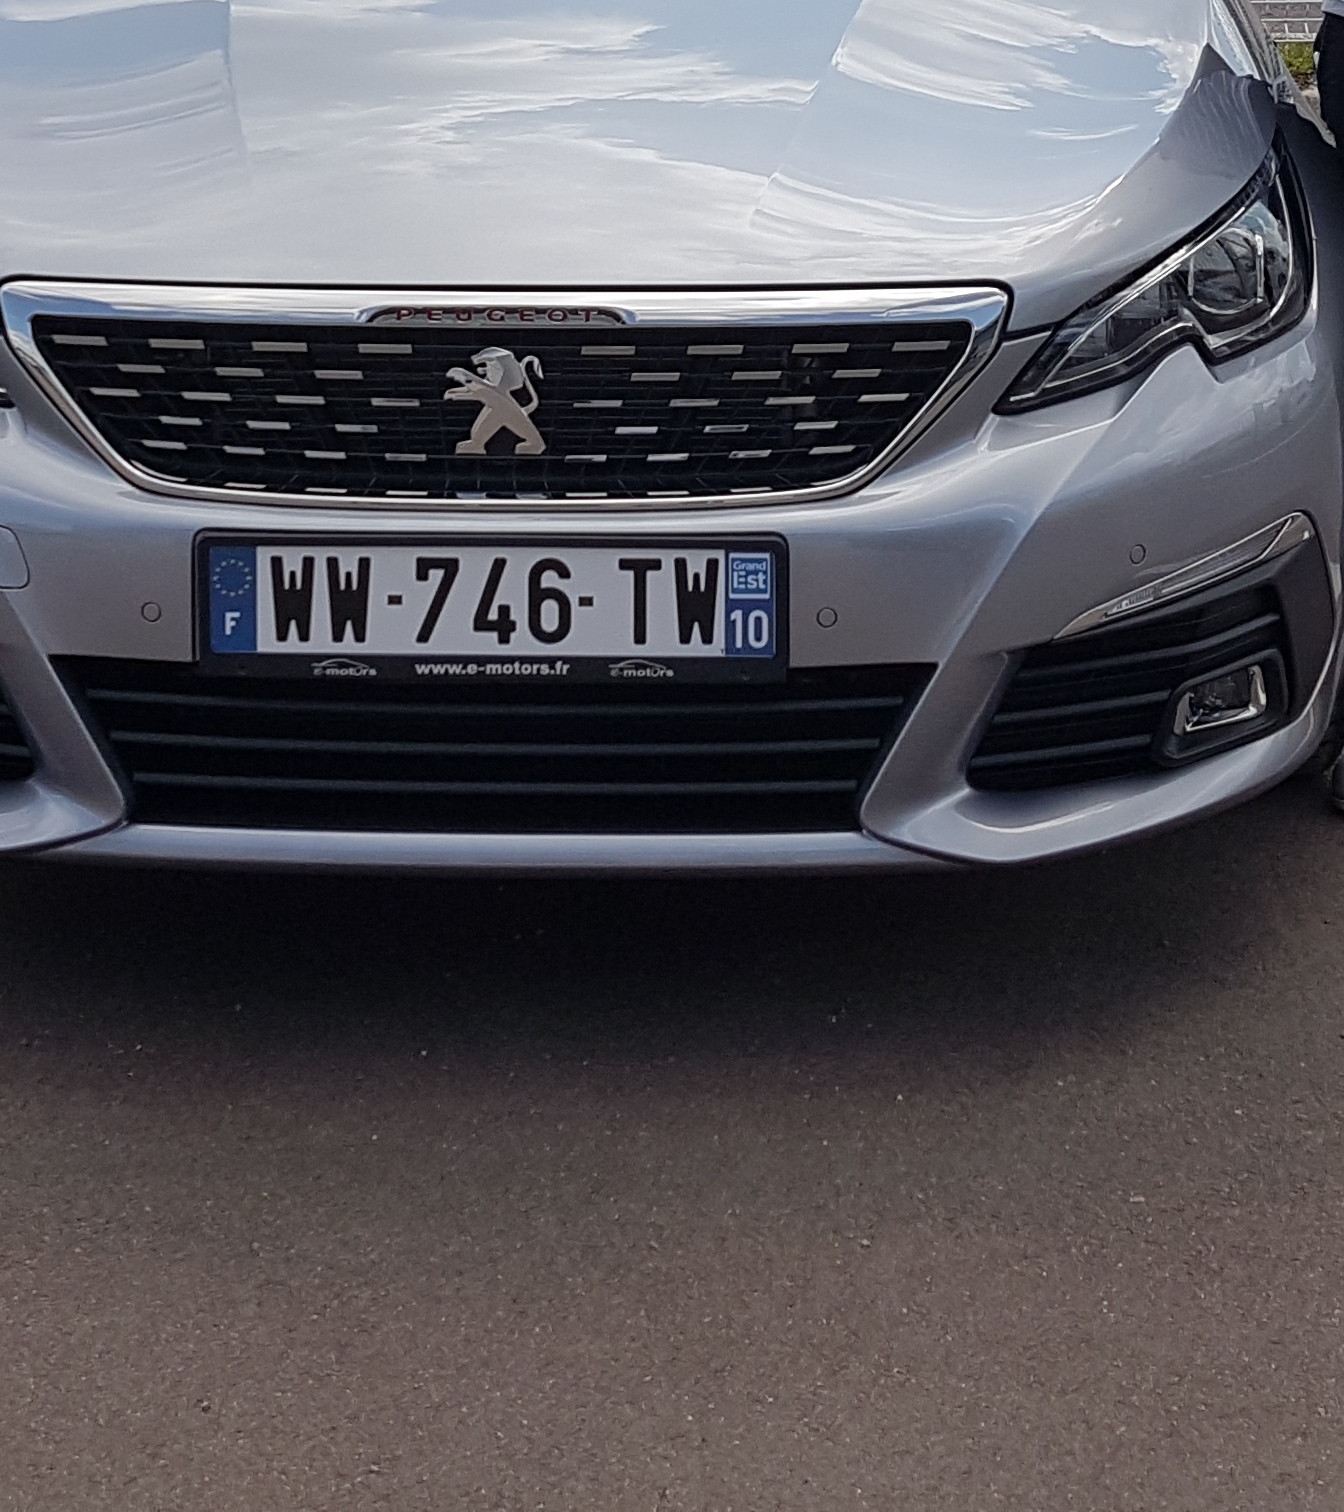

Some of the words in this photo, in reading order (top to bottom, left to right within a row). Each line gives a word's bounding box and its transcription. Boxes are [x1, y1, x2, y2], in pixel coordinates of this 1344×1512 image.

[394, 306, 599, 324] PEUGEOT
[732, 560, 768, 572] Grand
[732, 571, 768, 590] Est
[224, 611, 242, 637] F
[729, 608, 770, 650] 10
[413, 660, 571, 677] www.e-motors.fr
